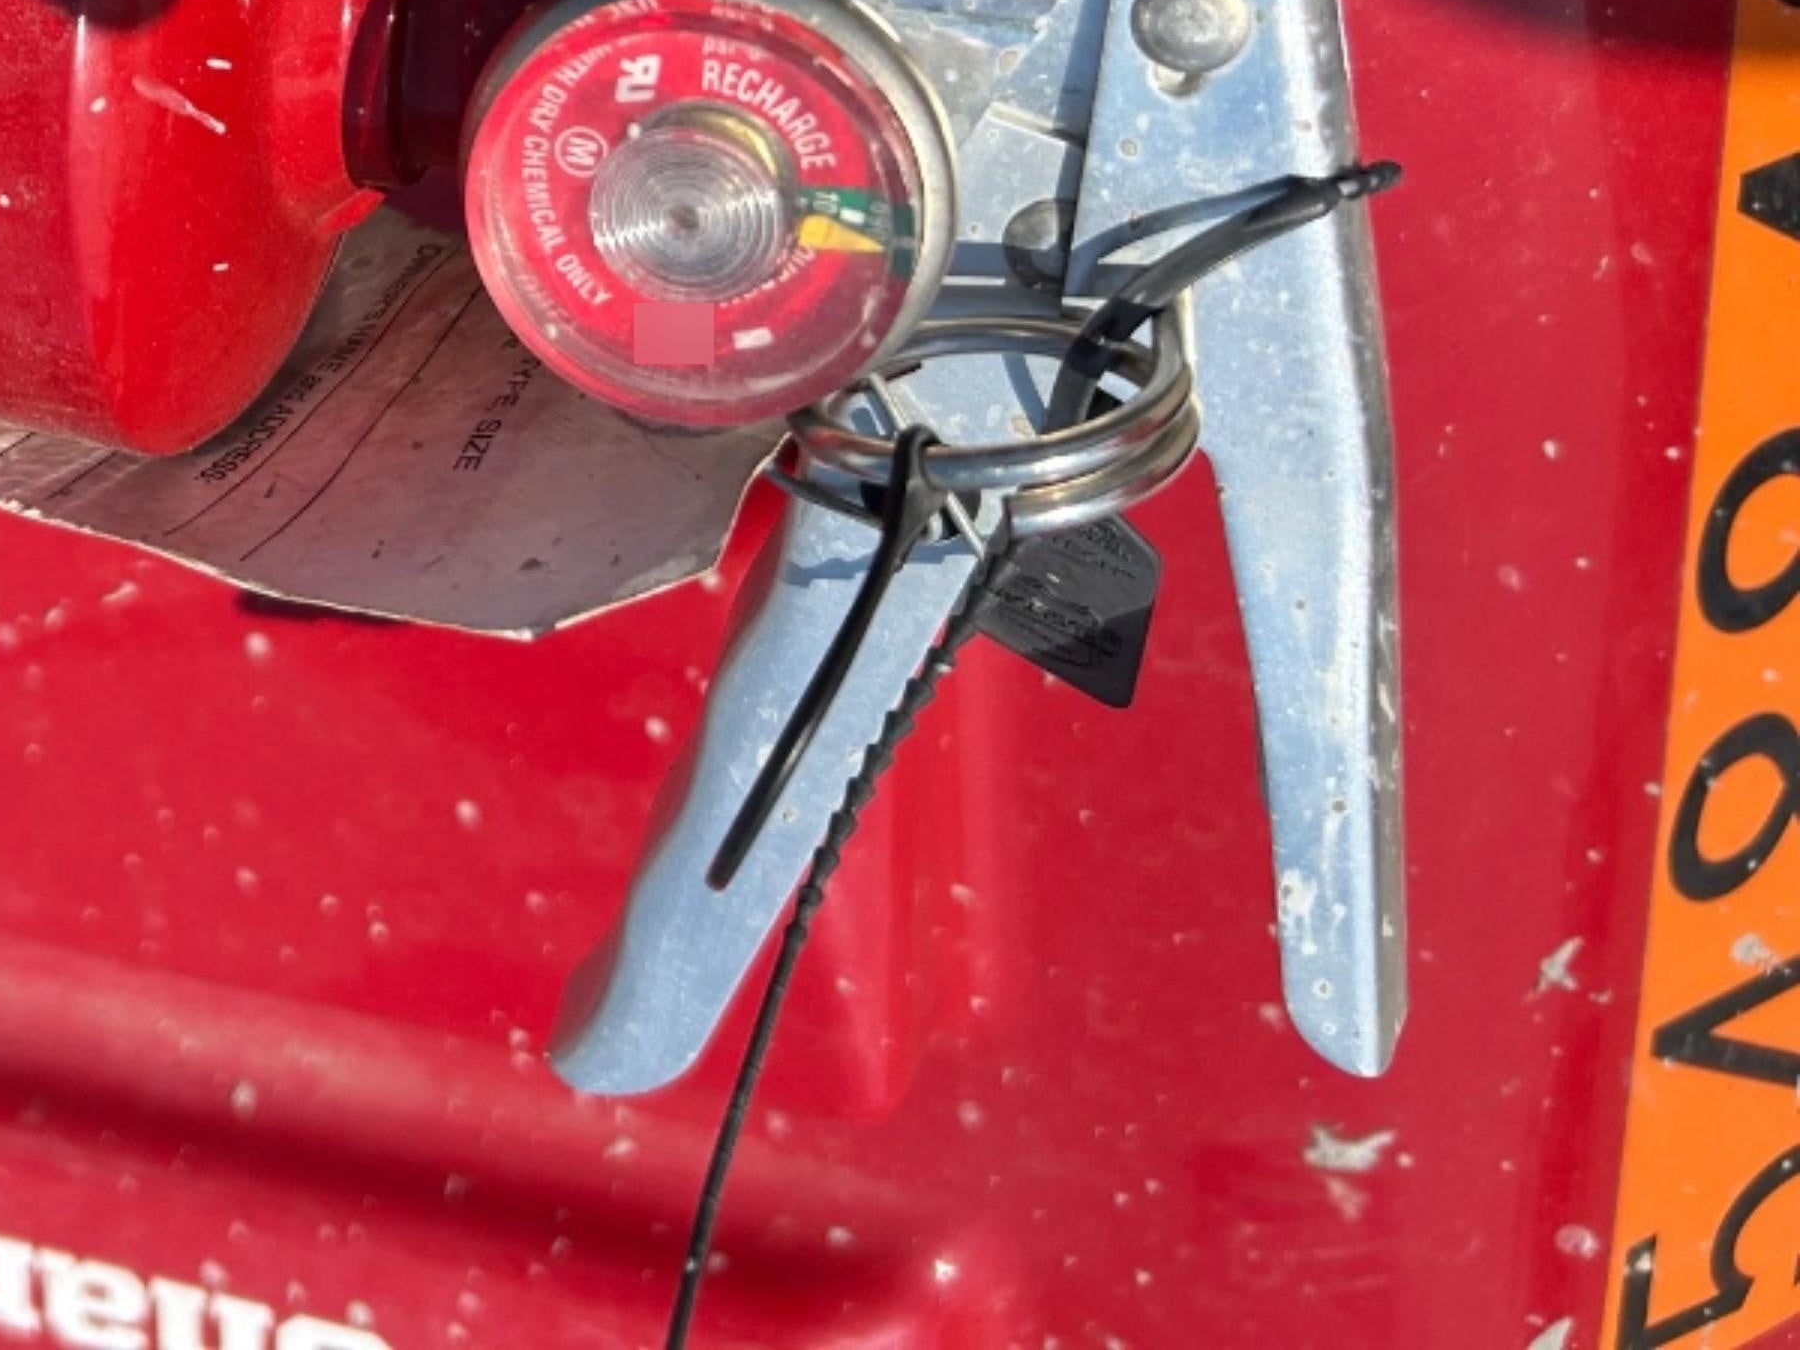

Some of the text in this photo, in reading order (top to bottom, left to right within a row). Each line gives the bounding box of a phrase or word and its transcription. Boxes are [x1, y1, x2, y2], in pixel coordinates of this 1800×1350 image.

[527, 86, 569, 129] DRY
[700, 60, 838, 172] RECHARGE
[519, 135, 566, 254] CHEMICAL
[555, 253, 613, 308] ONLY
